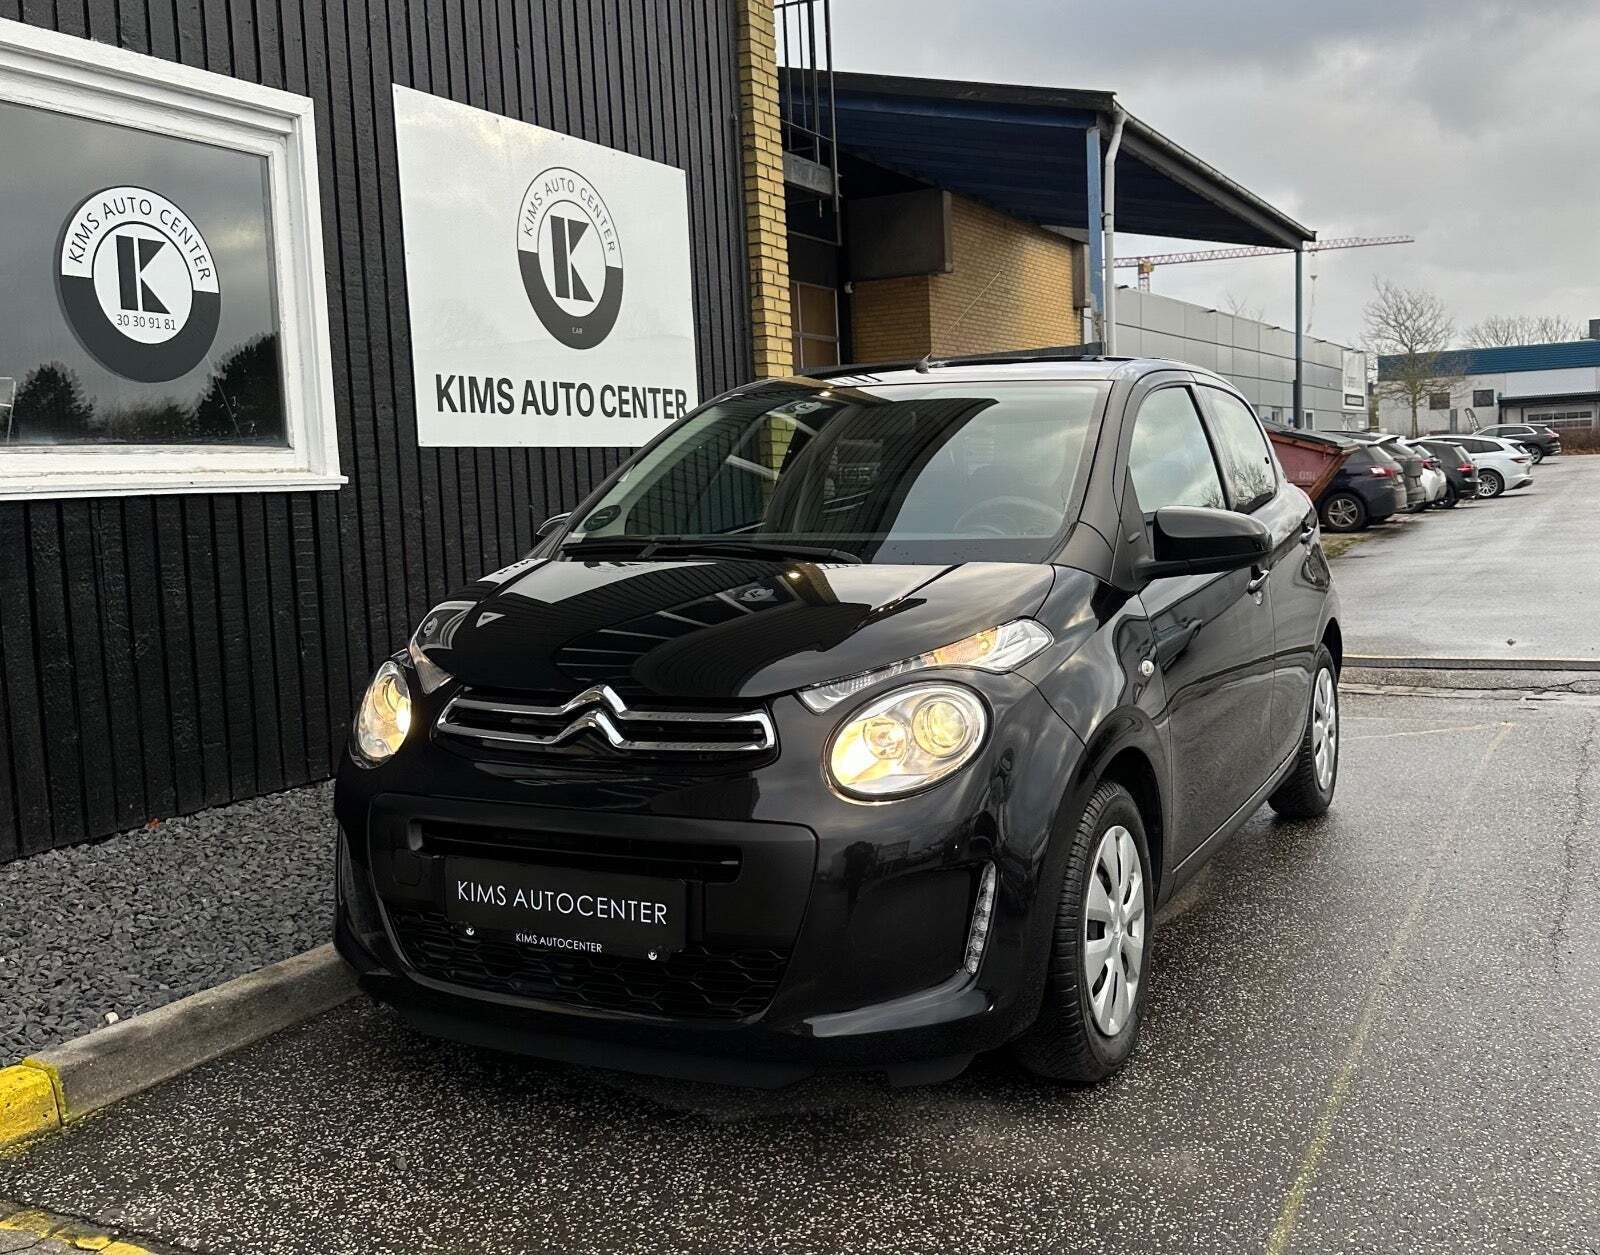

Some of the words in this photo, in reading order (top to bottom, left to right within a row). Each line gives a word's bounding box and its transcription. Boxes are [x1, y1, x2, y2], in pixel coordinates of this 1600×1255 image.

[69, 212, 100, 264] KIMS
[102, 197, 152, 220] AUTO
[160, 209, 211, 281] CENTER
[523, 192, 543, 237] KIMS
[544, 176, 575, 195] AUTO
[580, 187, 615, 254] CENTER
[116, 234, 171, 315] K
[550, 215, 595, 303] K
[116, 314, 130, 327] 30
[133, 315, 146, 328] 30
[148, 316, 161, 329] 91
[164, 318, 177, 331] 81
[435, 373, 515, 415] KIMS
[521, 379, 595, 418] AUTO
[600, 383, 688, 420] CENTER
[457, 880, 507, 907] KIMS
[513, 888, 667, 925] AUTOCENTER
[515, 932, 538, 945] KIMS
[539, 936, 602, 953] AUTOCENTER
